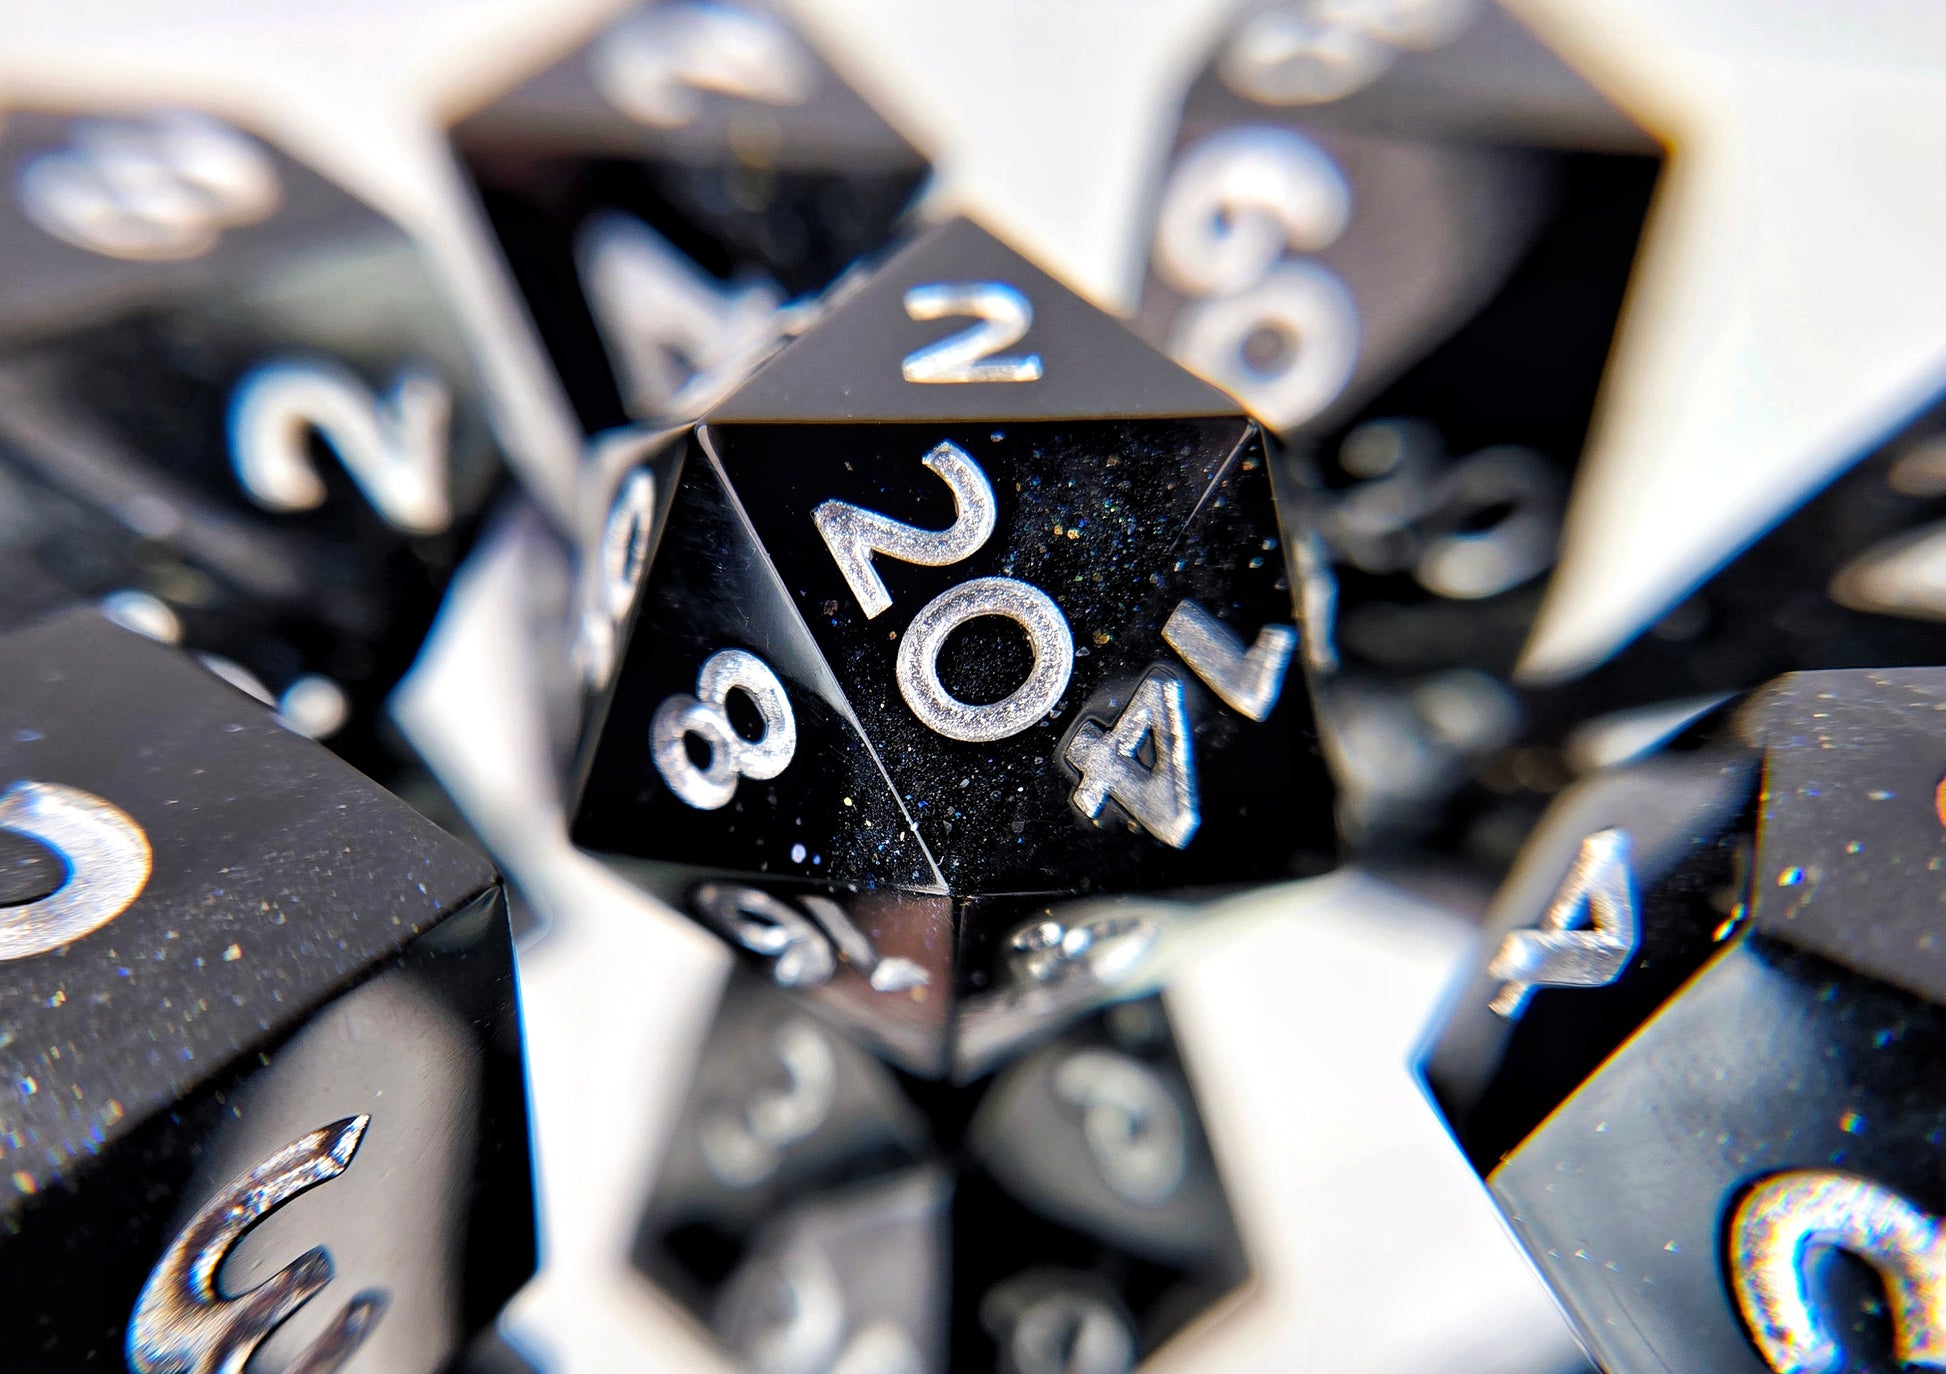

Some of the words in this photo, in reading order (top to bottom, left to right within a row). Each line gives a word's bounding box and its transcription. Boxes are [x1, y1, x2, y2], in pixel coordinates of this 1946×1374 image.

[900, 281, 1043, 384] 2
[228, 352, 450, 534] 2
[811, 440, 1074, 743] 20
[649, 648, 798, 810] 8
[1055, 598, 1297, 850] 14
